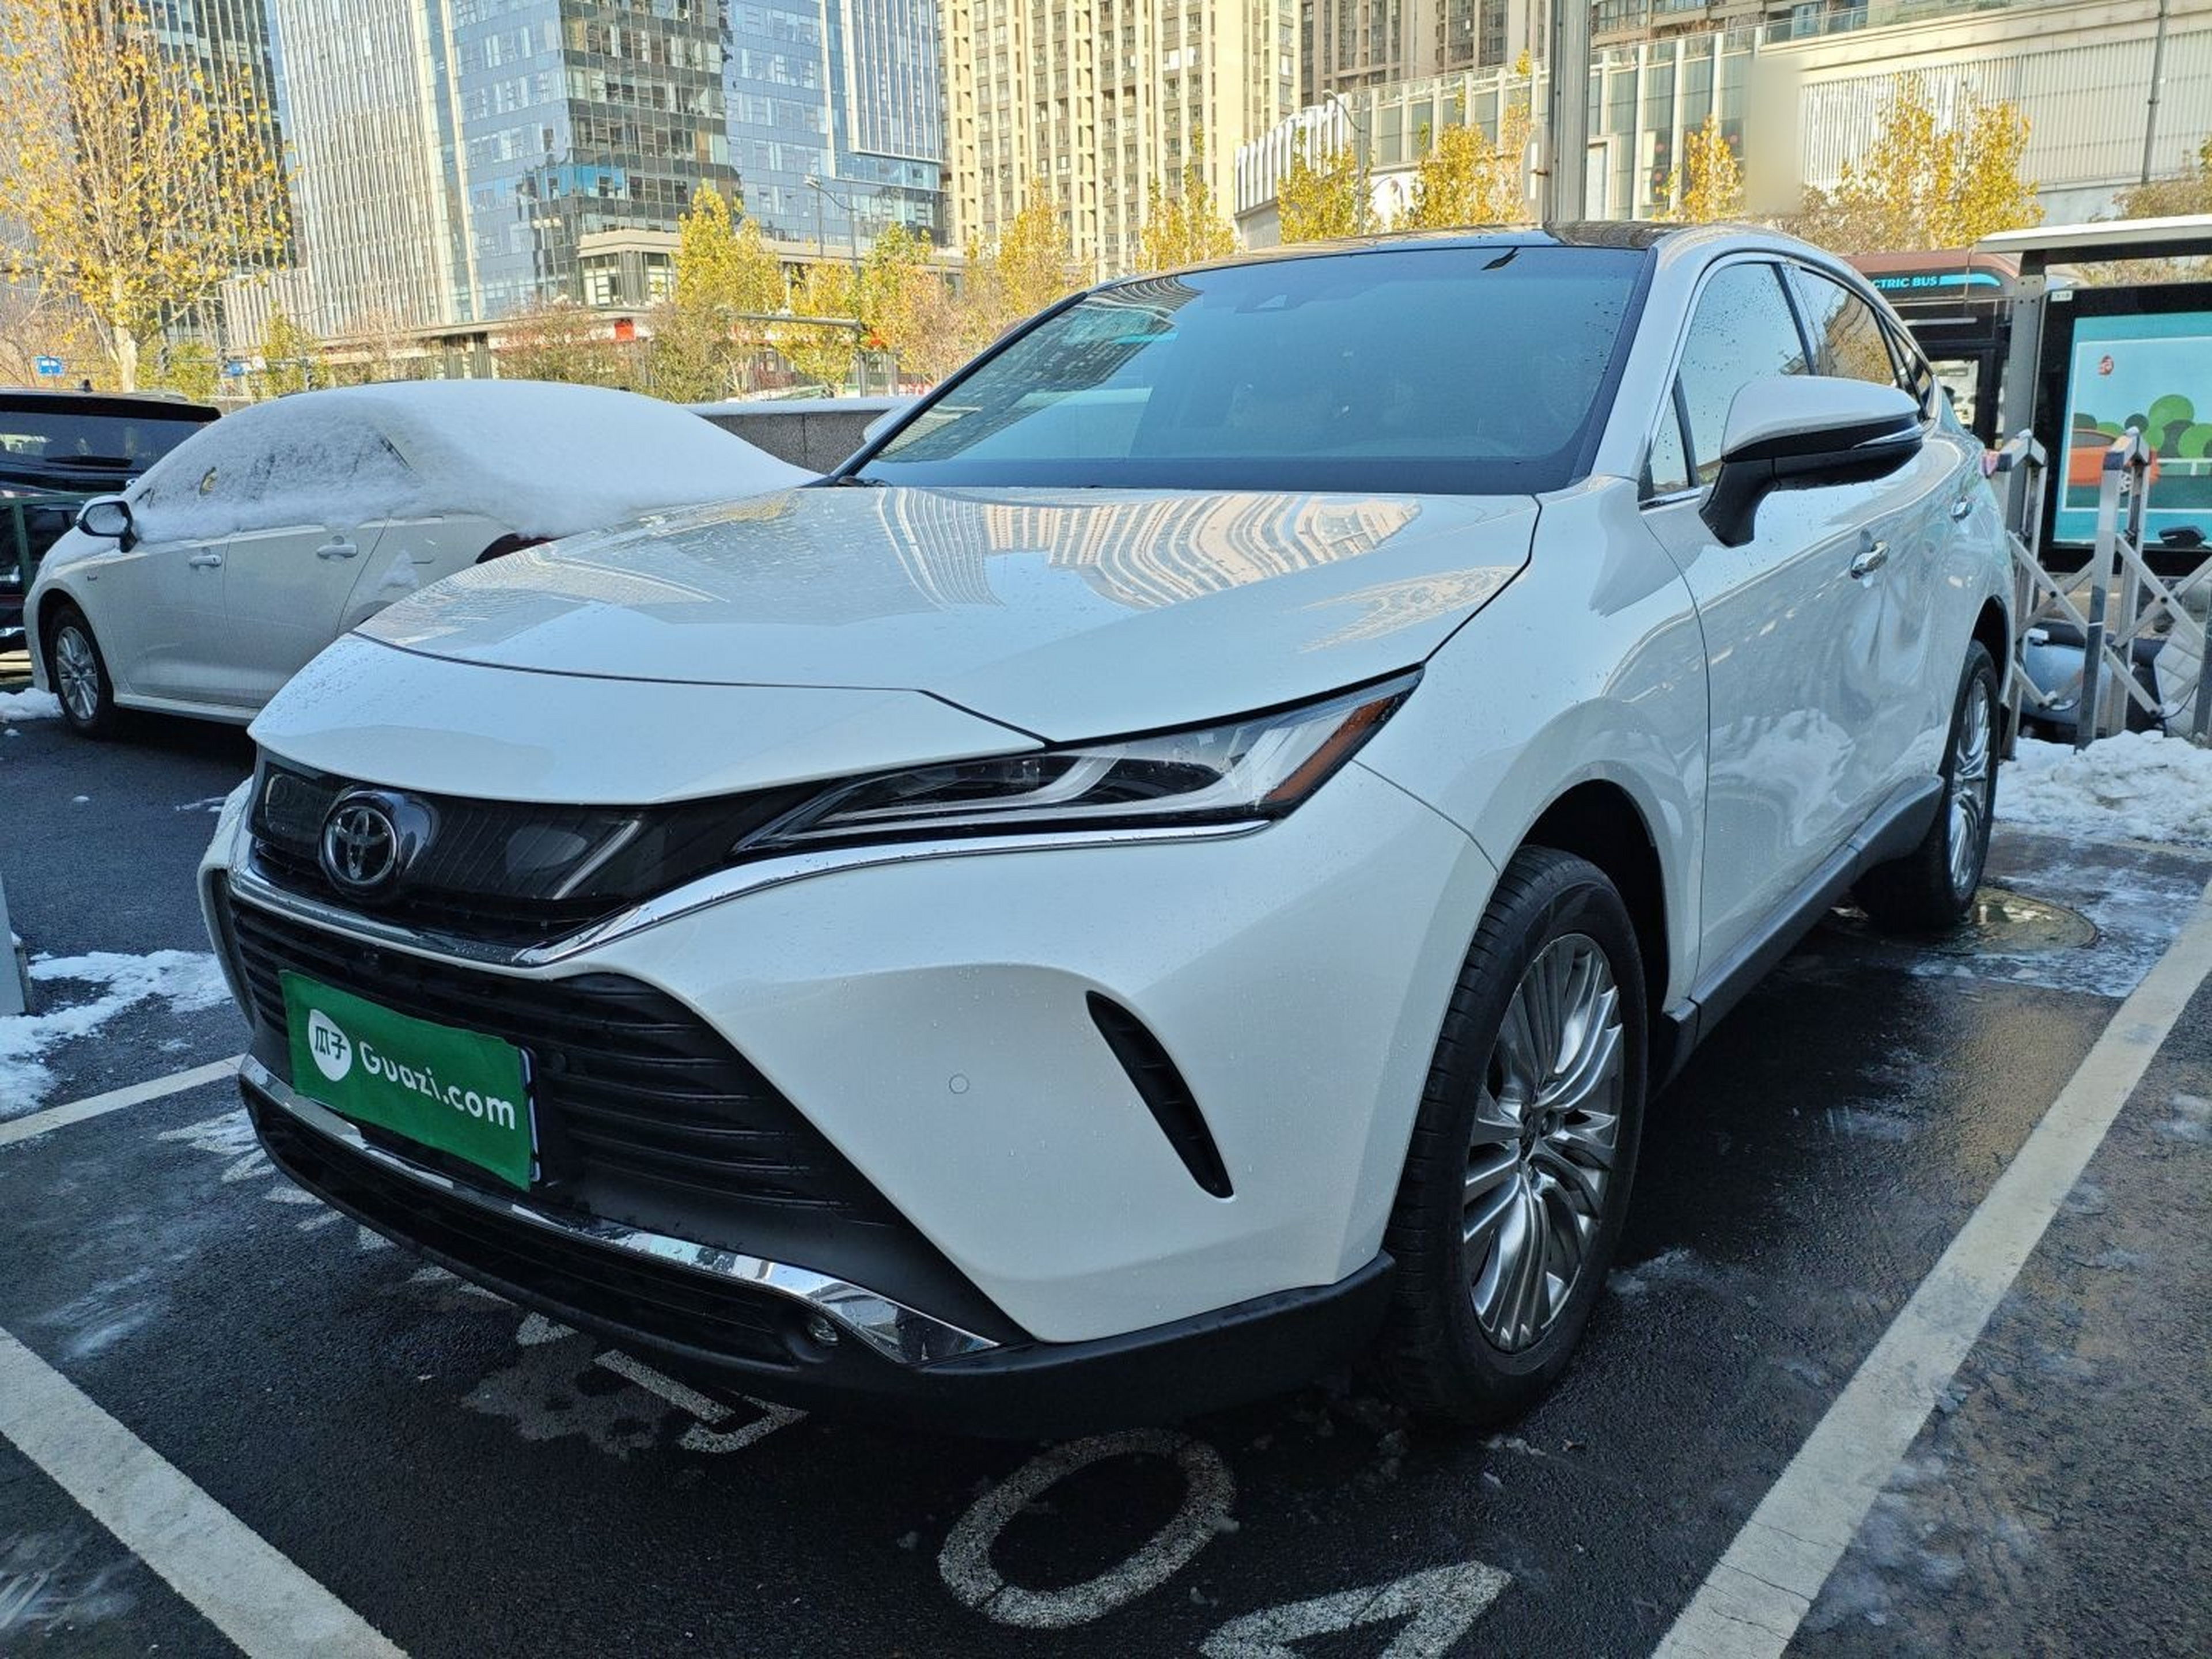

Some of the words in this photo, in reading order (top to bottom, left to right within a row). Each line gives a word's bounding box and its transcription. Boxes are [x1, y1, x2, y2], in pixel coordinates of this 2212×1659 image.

[1869, 278, 1910, 288] CTRIC
[1912, 276, 1938, 287] BUS
[315, 1025, 347, 1060] 瓜子
[359, 1040, 516, 1130] Guazi.com
